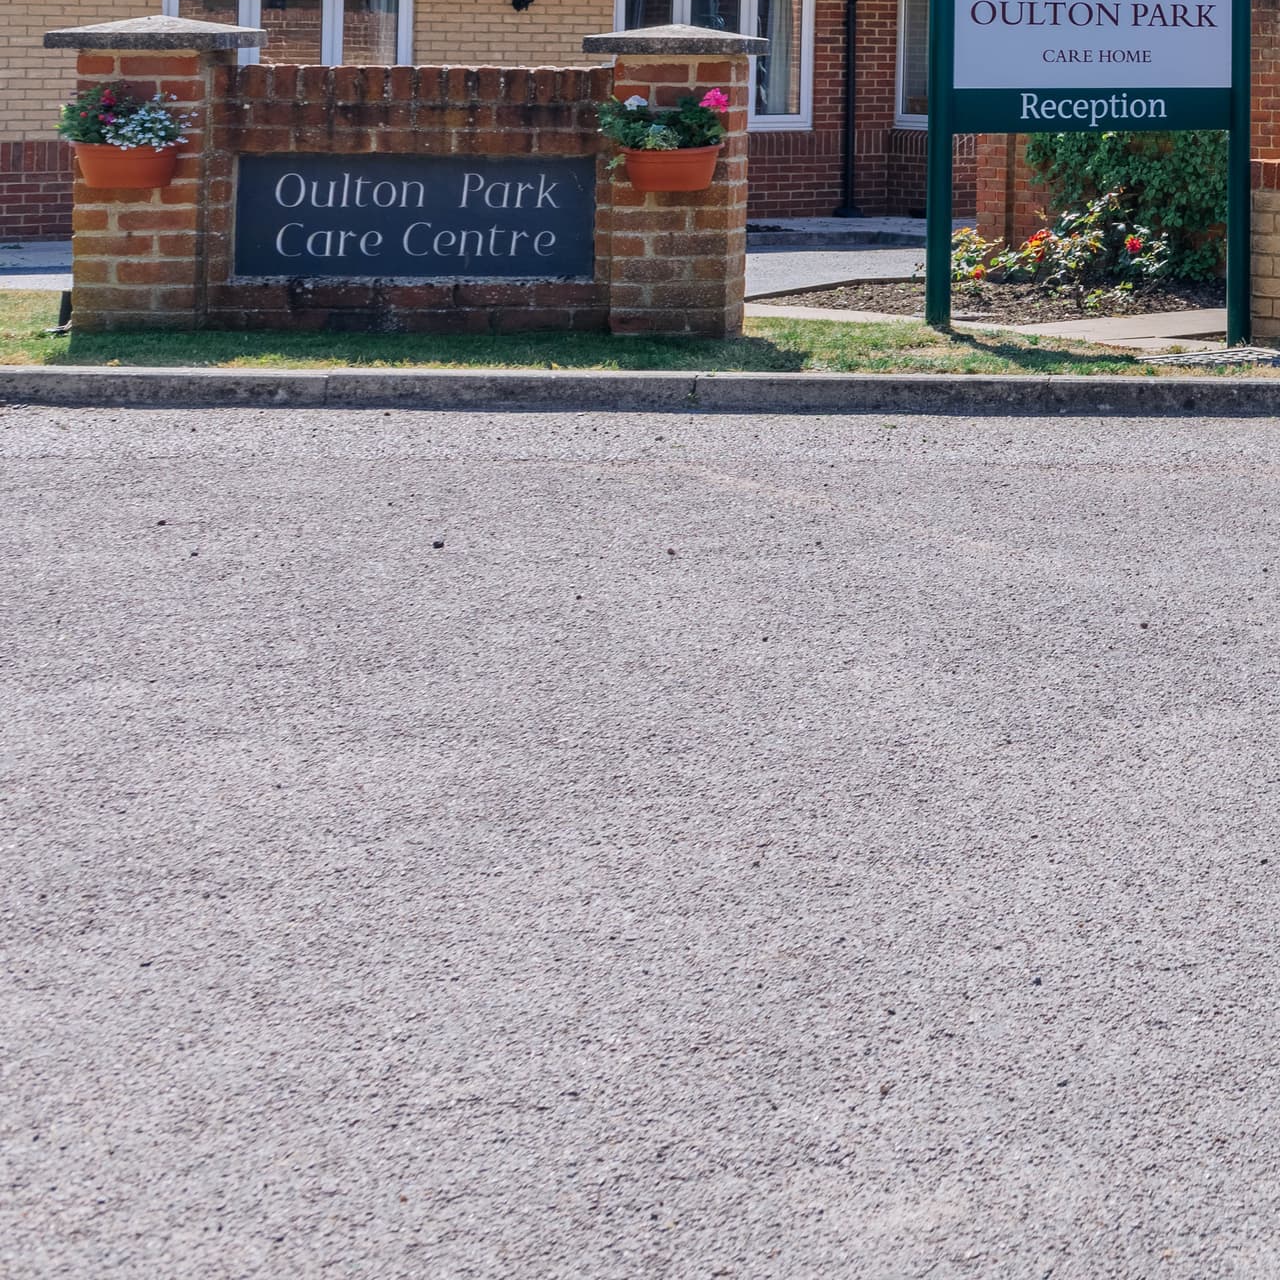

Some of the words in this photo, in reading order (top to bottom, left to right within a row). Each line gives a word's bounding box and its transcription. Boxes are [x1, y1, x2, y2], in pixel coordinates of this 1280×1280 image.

[970, 0, 1121, 27] OULTON
[1131, 3, 1219, 28] PARK
[1042, 49, 1094, 63] CARE
[1098, 49, 1152, 64] HOME
[1020, 92, 1168, 127] Reception
[274, 172, 426, 209] Oulton
[457, 172, 561, 209] Park
[274, 222, 384, 258] Care
[402, 221, 557, 258] Centre
